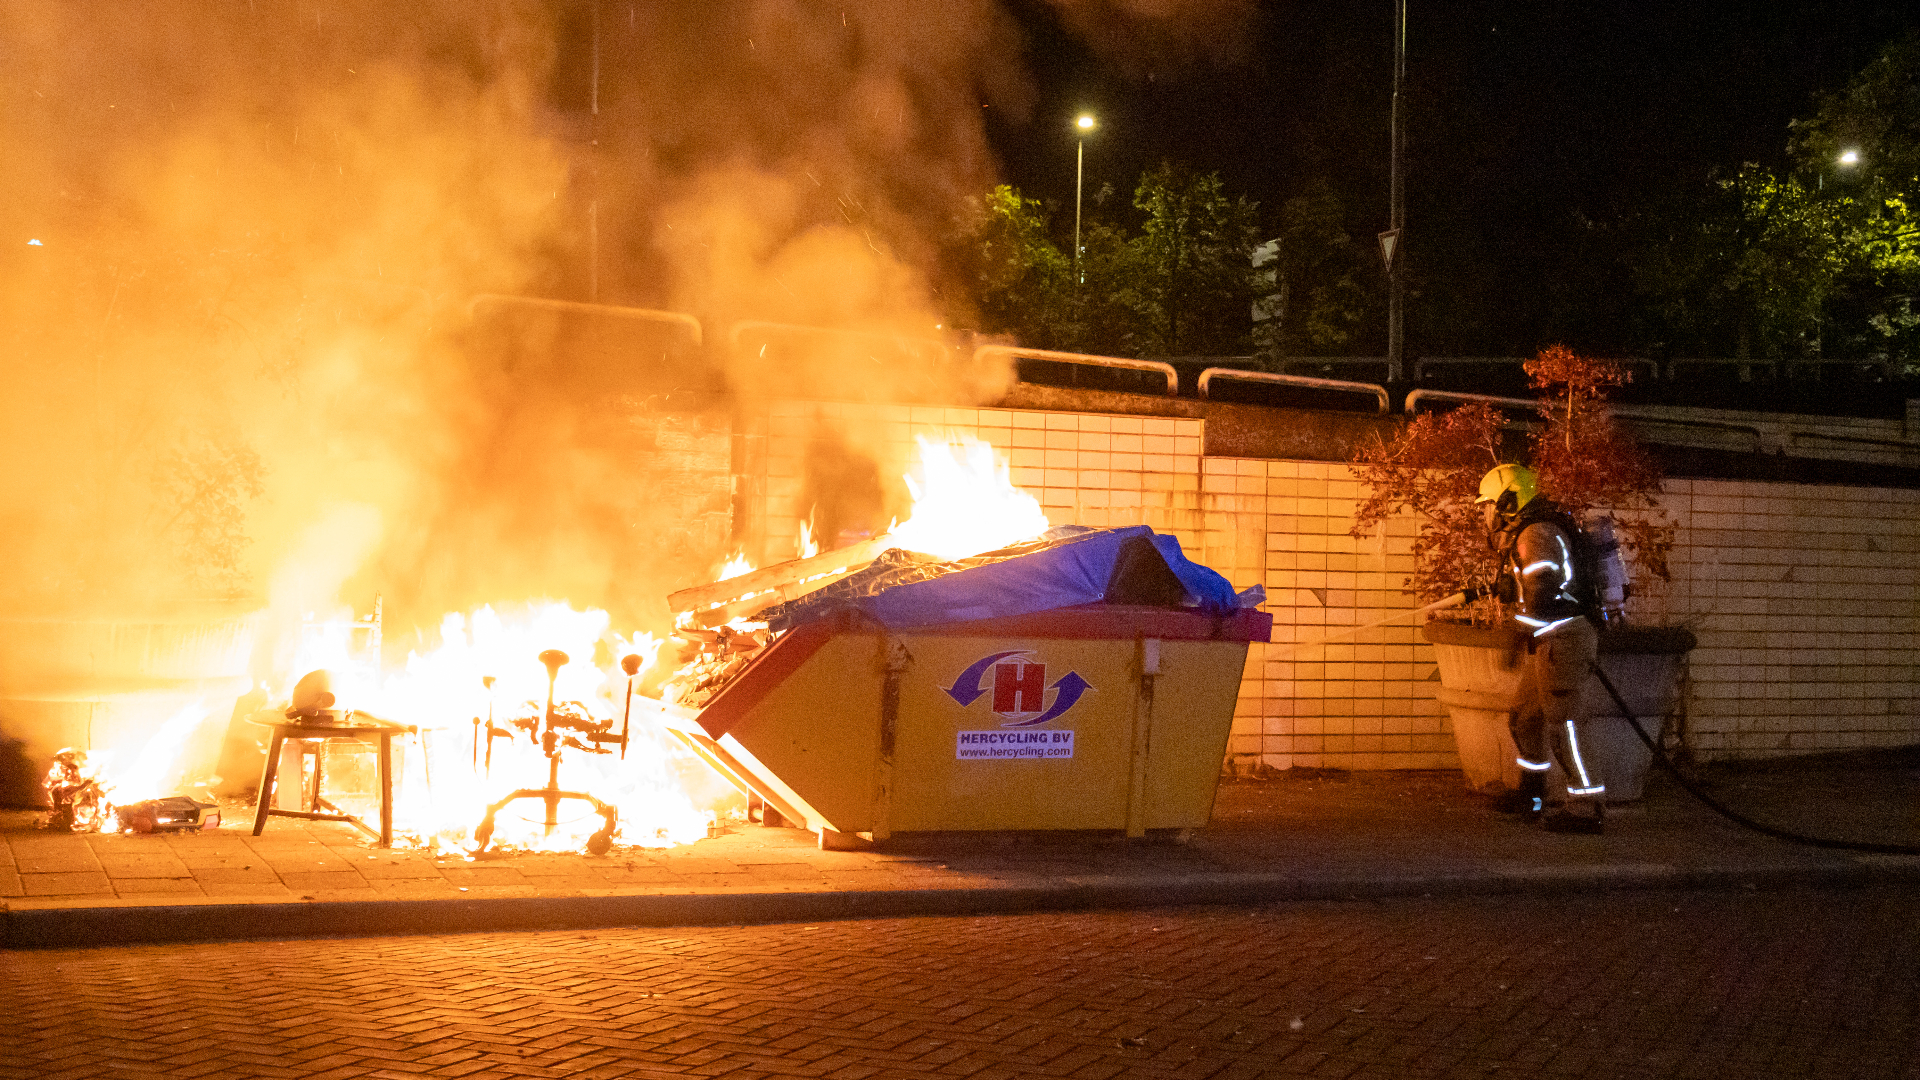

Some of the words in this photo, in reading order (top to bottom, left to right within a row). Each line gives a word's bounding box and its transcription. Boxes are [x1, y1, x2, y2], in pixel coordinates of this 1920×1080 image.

[993, 663, 1046, 713] H
[960, 733, 1048, 744] HERCYCLING
[1052, 732, 1071, 743] BV
[960, 746, 1071, 758] www.hercycling.com
